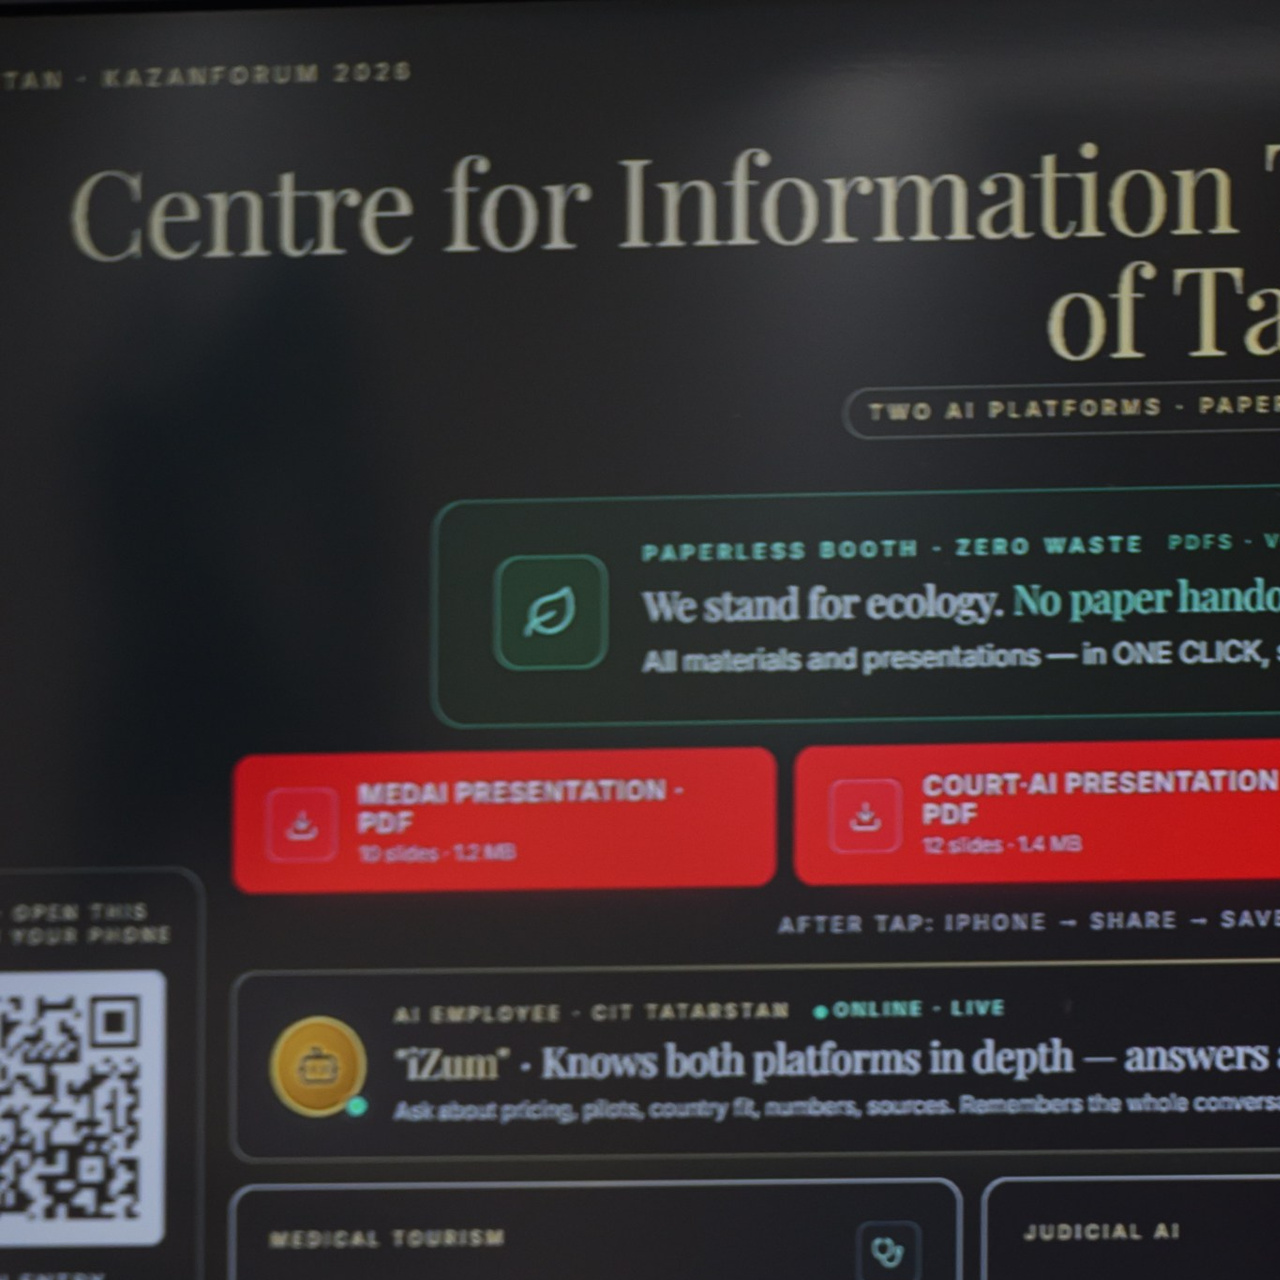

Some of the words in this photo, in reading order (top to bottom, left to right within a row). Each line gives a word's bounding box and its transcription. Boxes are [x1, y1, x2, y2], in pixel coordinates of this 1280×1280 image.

[71, 171, 413, 261] Centre
[444, 155, 592, 252] for
[618, 141, 1241, 247] Information
[1047, 261, 1157, 361] of
[868, 402, 932, 420] TWO
[945, 402, 974, 418] AI
[988, 397, 1161, 418] PLATFORMS
[641, 541, 806, 561] PAPERLESS
[819, 539, 917, 559] BOOTH
[955, 537, 1030, 556] ZERO
[1042, 535, 1142, 554] WASTE
[1168, 533, 1232, 550] PDFS
[641, 591, 698, 623] We
[703, 585, 801, 622] stand
[807, 585, 862, 620] for
[865, 582, 1005, 625] ecology.
[1013, 584, 1062, 616] No
[1069, 588, 1173, 622] paper
[642, 650, 678, 673] All
[682, 647, 803, 672] materials
[806, 646, 858, 670] and
[862, 642, 1042, 675] presentations
[1082, 641, 1108, 665] in
[1112, 640, 1173, 665] ONE
[1178, 639, 1270, 668] CLICK,
[357, 782, 449, 805] MEDAI
[454, 779, 667, 803] PRESENTATION
[1064, 769, 1280, 794] PRESENTATION
[357, 811, 414, 834] PDF
[922, 802, 978, 825] PDF
[778, 914, 862, 933] AFTER
[874, 914, 933, 931] TAP:
[944, 912, 1045, 931] IPHONE
[1090, 910, 1176, 930] SHARE
[542, 1047, 659, 1079] Knows
[665, 1041, 746, 1077] both
[753, 1040, 922, 1084] platforms
[929, 1039, 965, 1074] in
[971, 1037, 1075, 1080] depth
[1124, 1045, 1270, 1072] answers
[1023, 1223, 1142, 1241] JUDICIAL
[1153, 1223, 1180, 1238] AI
